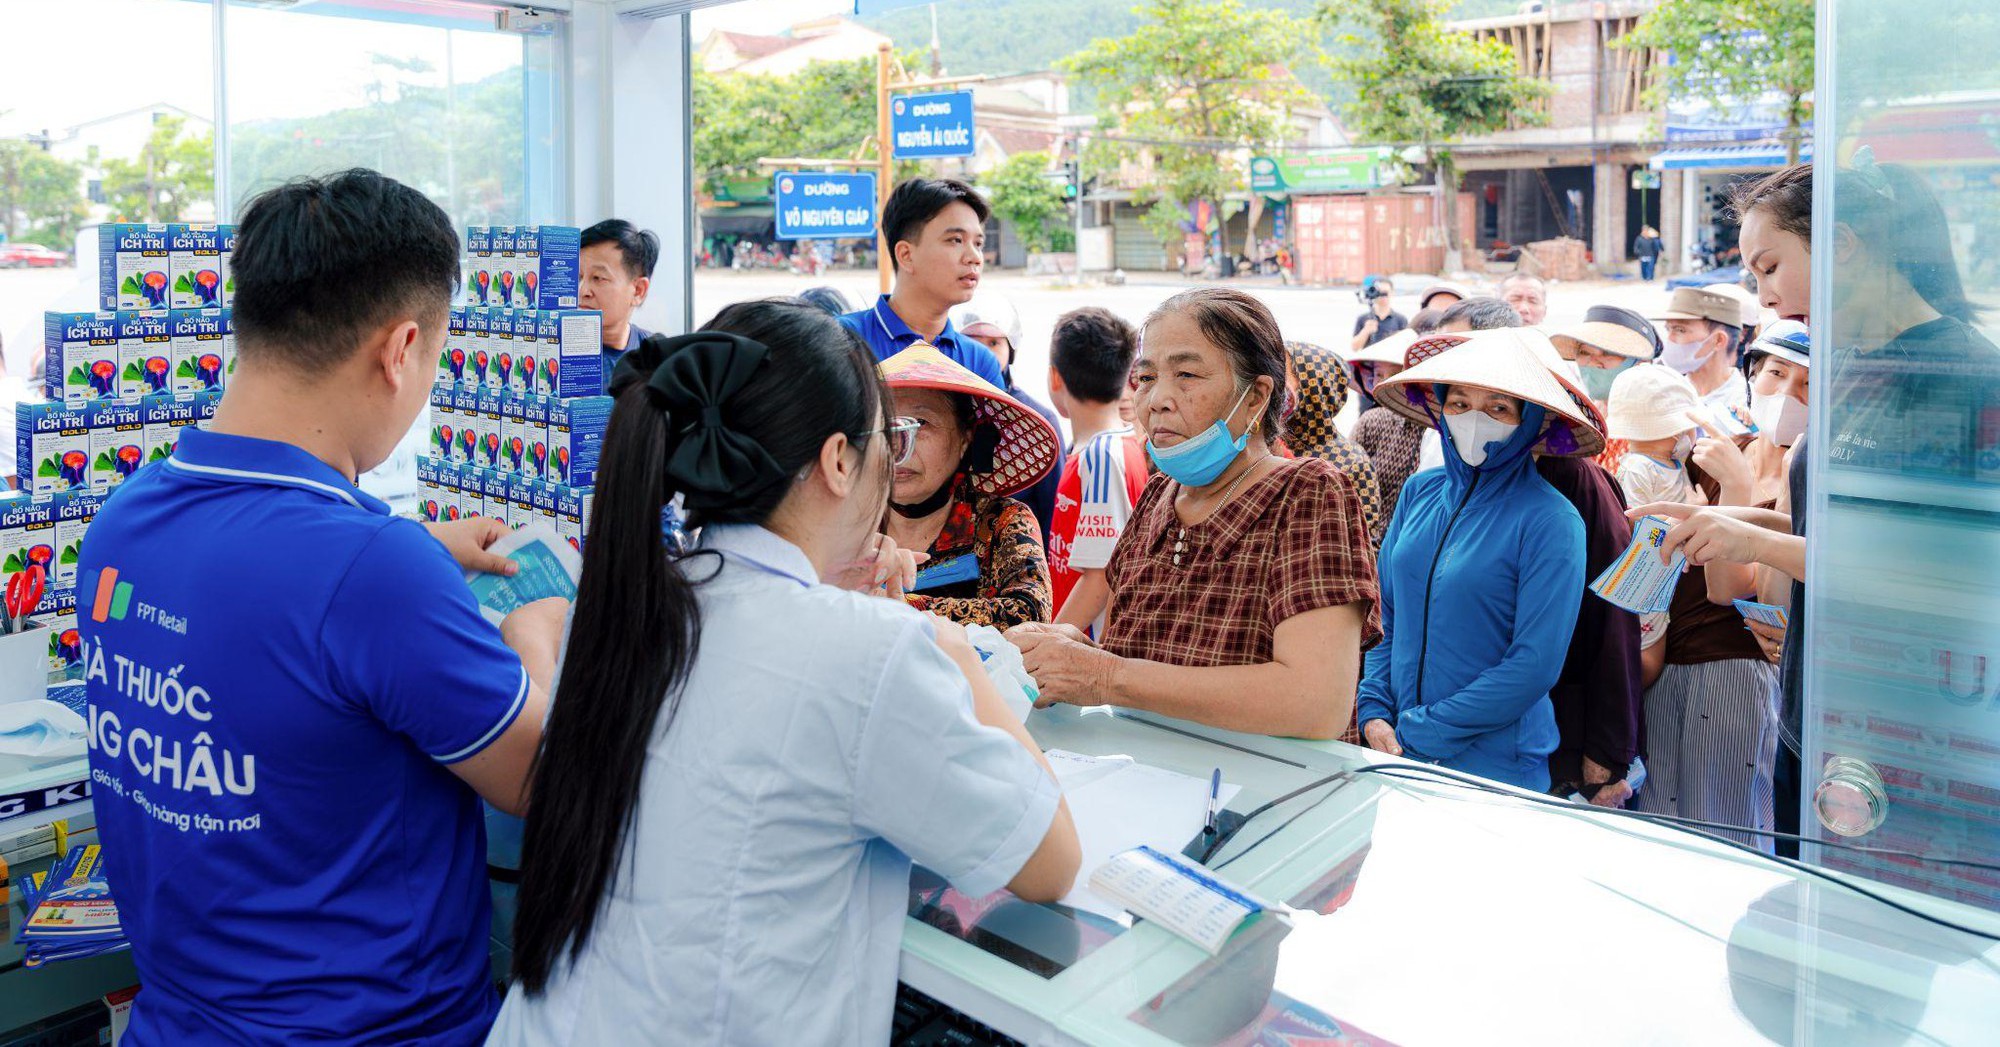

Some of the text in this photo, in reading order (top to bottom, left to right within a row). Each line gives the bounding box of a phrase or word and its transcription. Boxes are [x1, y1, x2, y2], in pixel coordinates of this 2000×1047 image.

[898, 122, 969, 148] NGUYỄN ÁI QUỐC
[804, 180, 850, 196] ĐƯỜNG
[785, 206, 869, 227] VÕ NGUYÊN GIÁP
[121, 237, 164, 248] ÍCH TRÍ
[174, 237, 215, 248] ÍCH TRÍ
[68, 325, 113, 338] ÍCH TRÍ
[123, 325, 166, 336] ÍCH TRÍ
[177, 321, 218, 333] ÍCH TRÍ
[227, 320, 235, 331] ÍC
[149, 407, 192, 420] ÍCH TRÍ
[202, 406, 217, 416] ÍC
[38, 415, 84, 430] ÍCH TRÍ
[94, 411, 138, 425] ÍCH TRÍ
[3, 508, 50, 526] ÍCH TRÍ
[60, 505, 82, 518] ÍCH
[27, 522, 53, 530] GOLD
[1080, 515, 1112, 526] VISIT
[1076, 527, 1119, 538] WAND
[35, 596, 76, 612] CH TR
[137, 602, 187, 635] FPT Retail
[114, 654, 212, 721] THUỐC
[128, 732, 255, 796] CHÂU
[93, 769, 111, 787] Giá
[153, 803, 190, 832] hàng
[194, 814, 224, 834] tận
[229, 813, 261, 832] nơi
